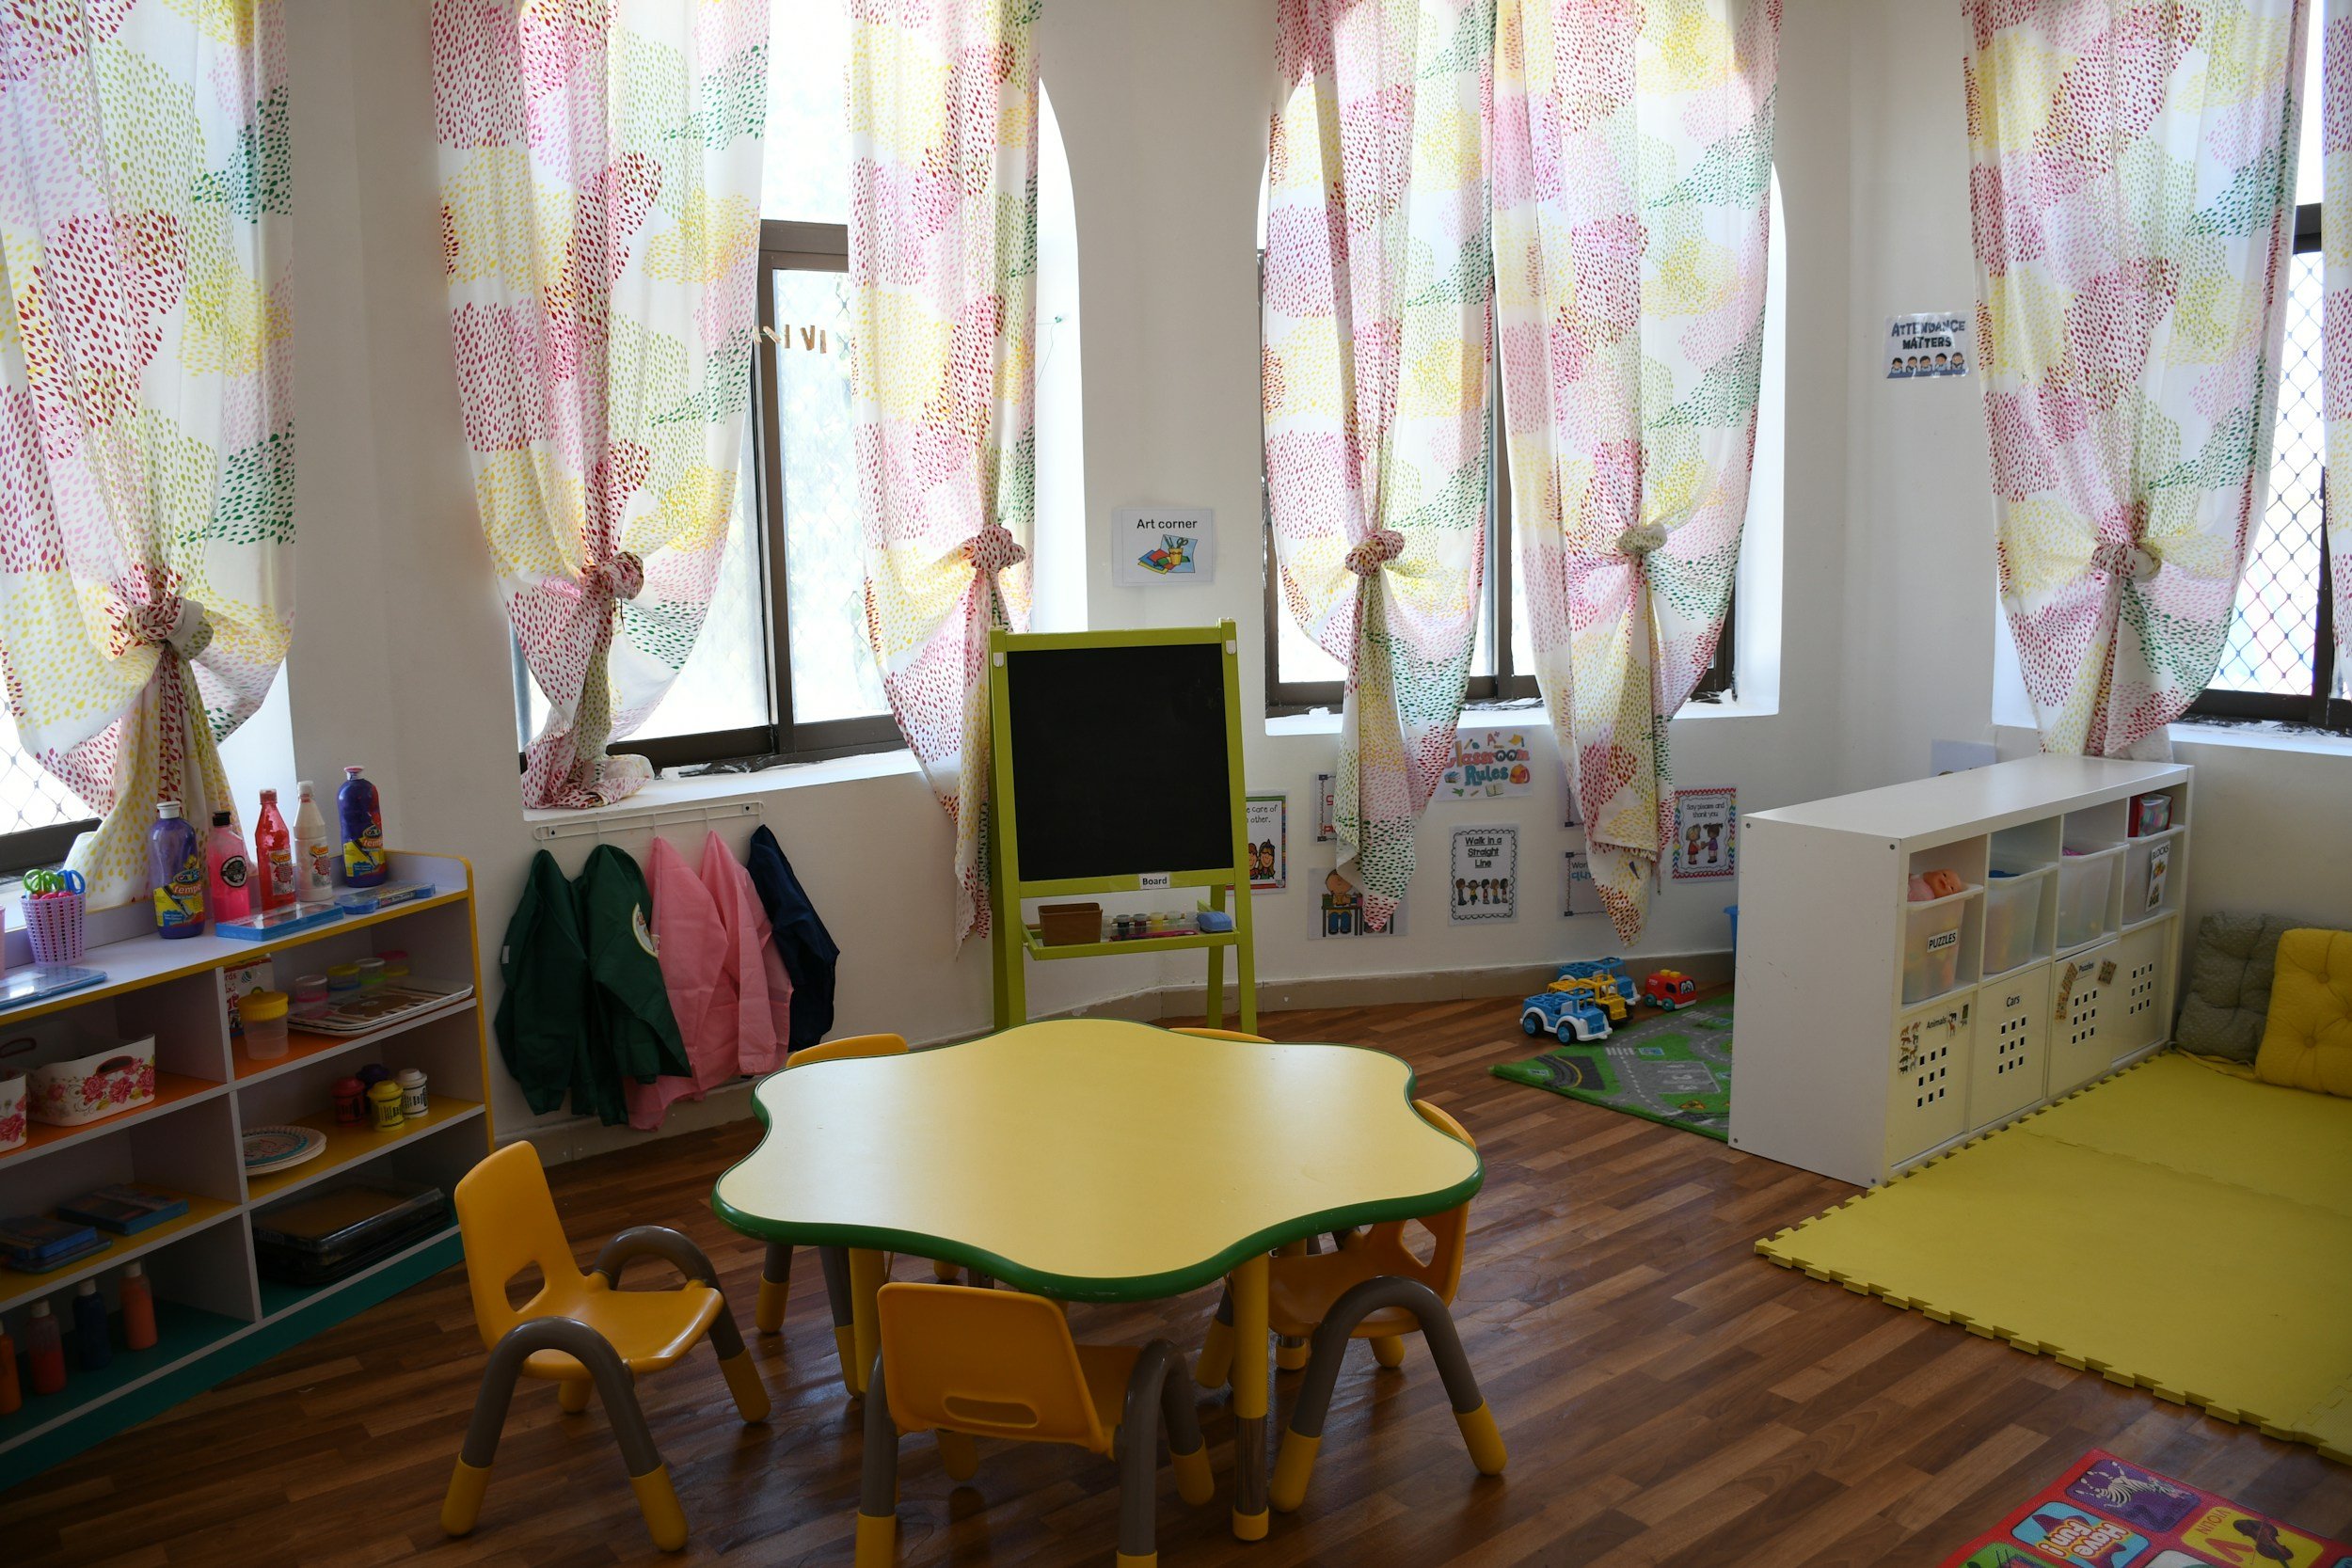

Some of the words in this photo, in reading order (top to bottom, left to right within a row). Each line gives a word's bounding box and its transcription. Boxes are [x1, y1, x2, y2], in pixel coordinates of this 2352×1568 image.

[1891, 320, 1965, 337] ATTENDANCE
[1902, 337, 1952, 350] MATTERS
[1136, 518, 1155, 529] Art
[1158, 520, 1198, 529] corner
[1465, 765, 1509, 786] Rules
[1465, 836, 1485, 846] Walk
[1468, 847, 1499, 857] Straight
[2153, 844, 2169, 860] BLOCKS
[1475, 859, 1492, 868] Line
[1142, 877, 1168, 886] Board
[1928, 932, 1956, 949] PUZZLES
[2006, 996, 2020, 1007] Cars
[1926, 1016, 1947, 1030] Animals
[2195, 1508, 2232, 1535] VIOLIN
[2072, 1522, 2128, 1557] Have
[2204, 1537, 2256, 1563] V
